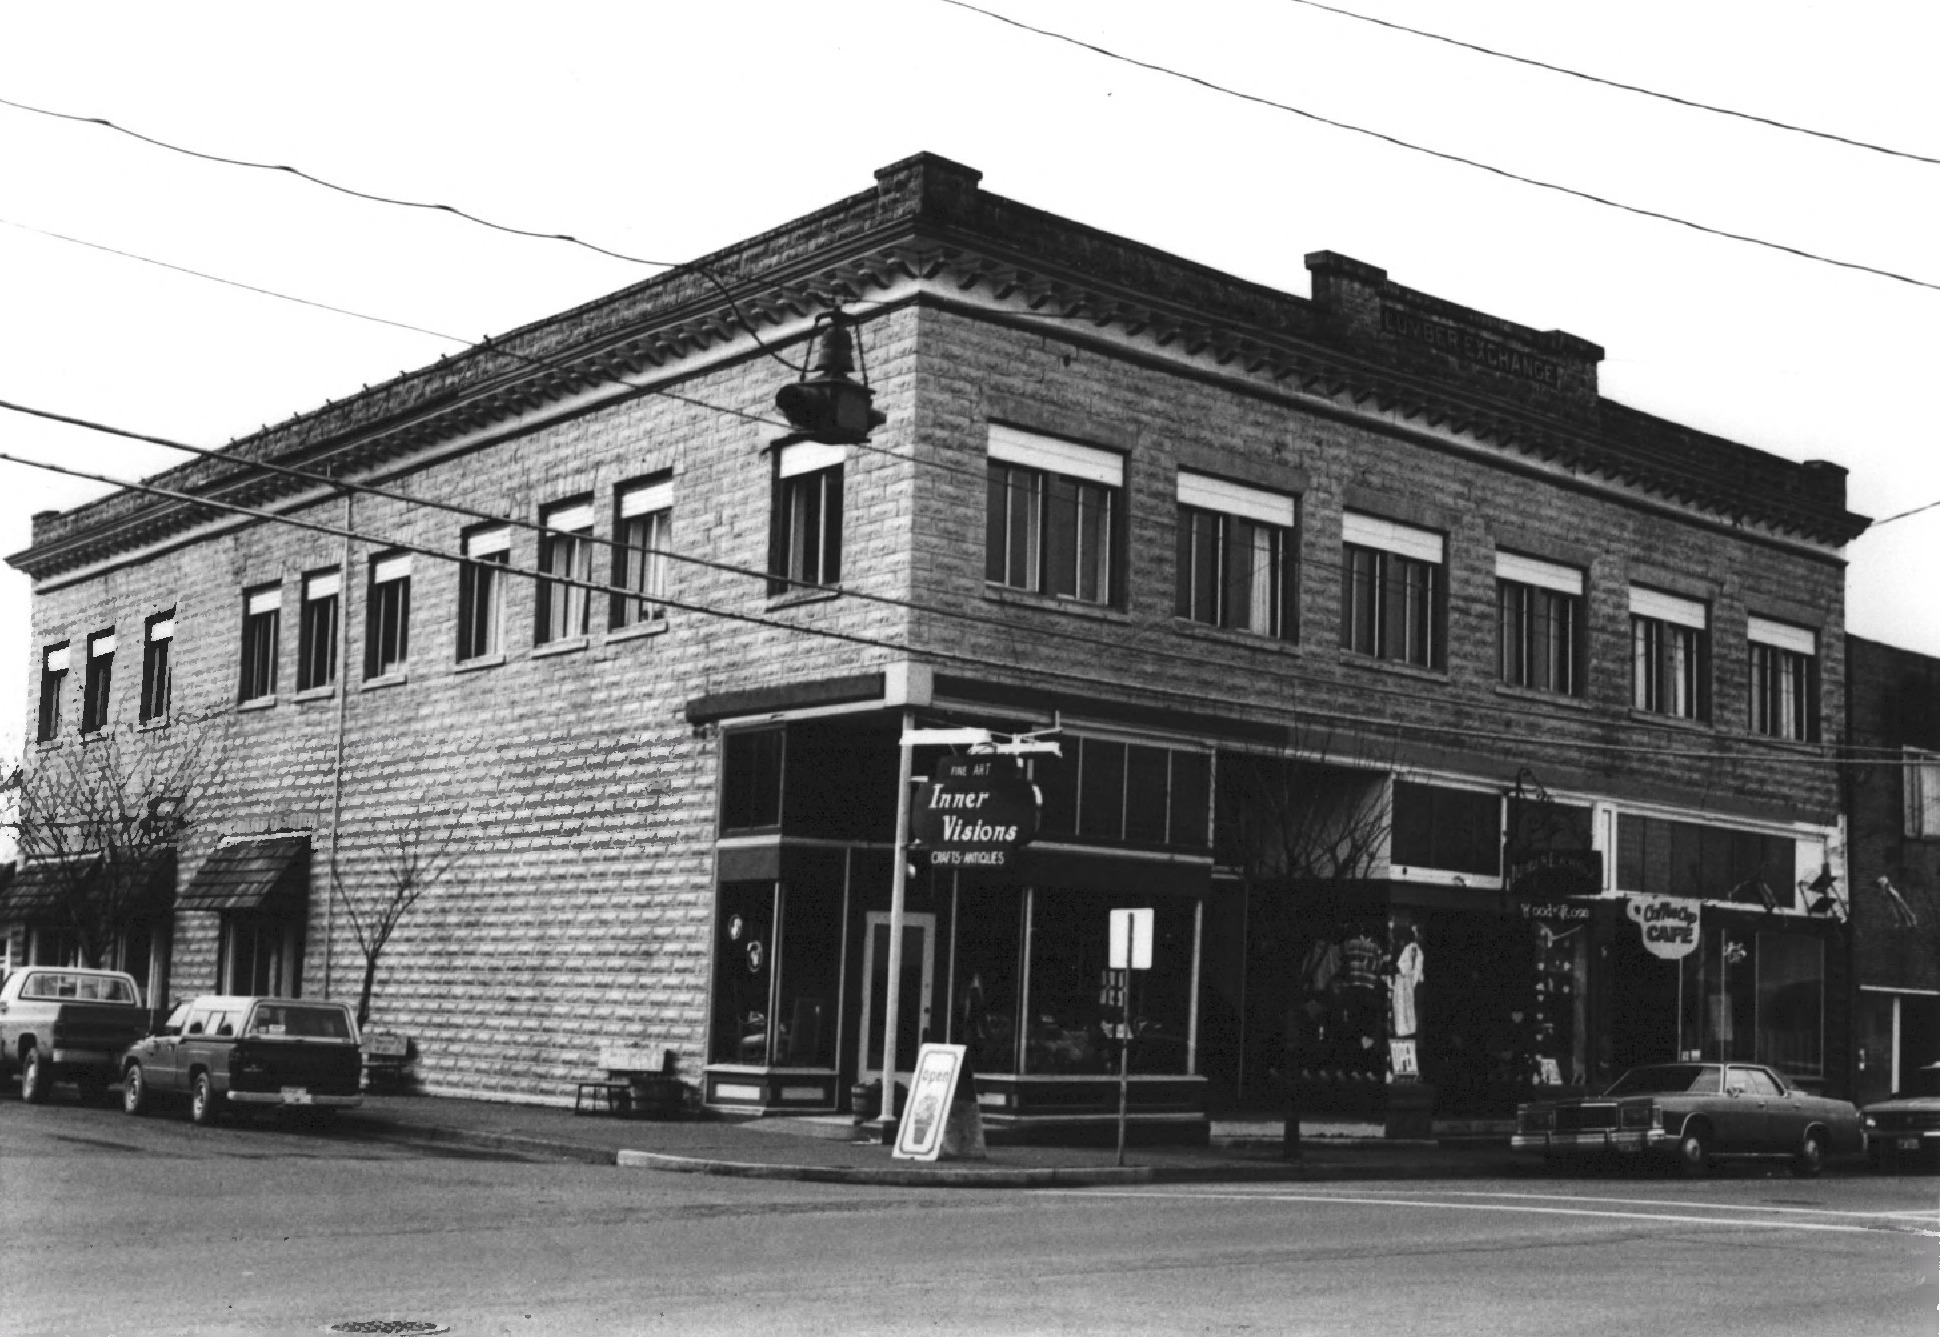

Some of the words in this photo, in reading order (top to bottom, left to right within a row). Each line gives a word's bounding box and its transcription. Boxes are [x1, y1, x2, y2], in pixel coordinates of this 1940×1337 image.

[1384, 308, 1458, 346] LUMBER
[1463, 334, 1555, 383] EXCHANGE
[951, 766, 967, 776] FINE
[973, 763, 991, 776] ART
[928, 783, 990, 808] Inner
[942, 815, 1018, 841] Visions
[1647, 926, 1694, 944] CAFE
